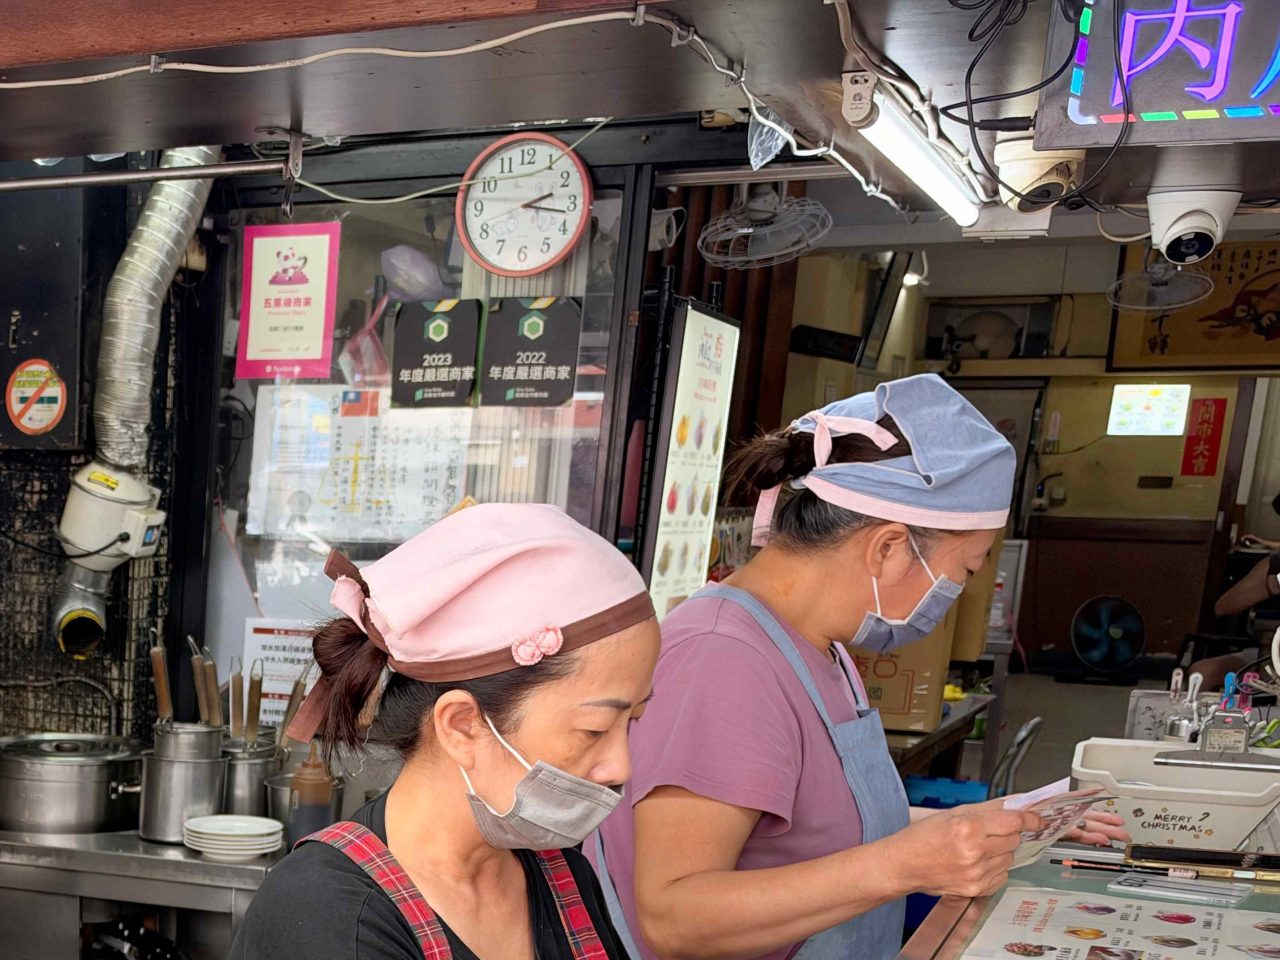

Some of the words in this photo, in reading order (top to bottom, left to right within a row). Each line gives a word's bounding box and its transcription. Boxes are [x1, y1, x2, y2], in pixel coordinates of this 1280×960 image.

[520, 148, 536, 165] 12
[548, 154, 554, 170] 1
[500, 157, 513, 174] 11
[481, 177, 497, 193] 10
[560, 171, 570, 188] 2
[474, 200, 484, 217] 9
[567, 194, 577, 212] 3
[480, 223, 489, 240] 8
[558, 219, 568, 235] 4
[496, 240, 505, 255] 7
[540, 237, 551, 253] 5
[517, 246, 528, 262] 6
[422, 353, 453, 366] 2023
[515, 352, 546, 364] 2022
[399, 366, 476, 383] 年度嚴選商家
[489, 365, 571, 381] 年度嚴選商家
[1153, 814, 1193, 824] MERRY
[1141, 821, 1203, 834] CHRISTMAS
